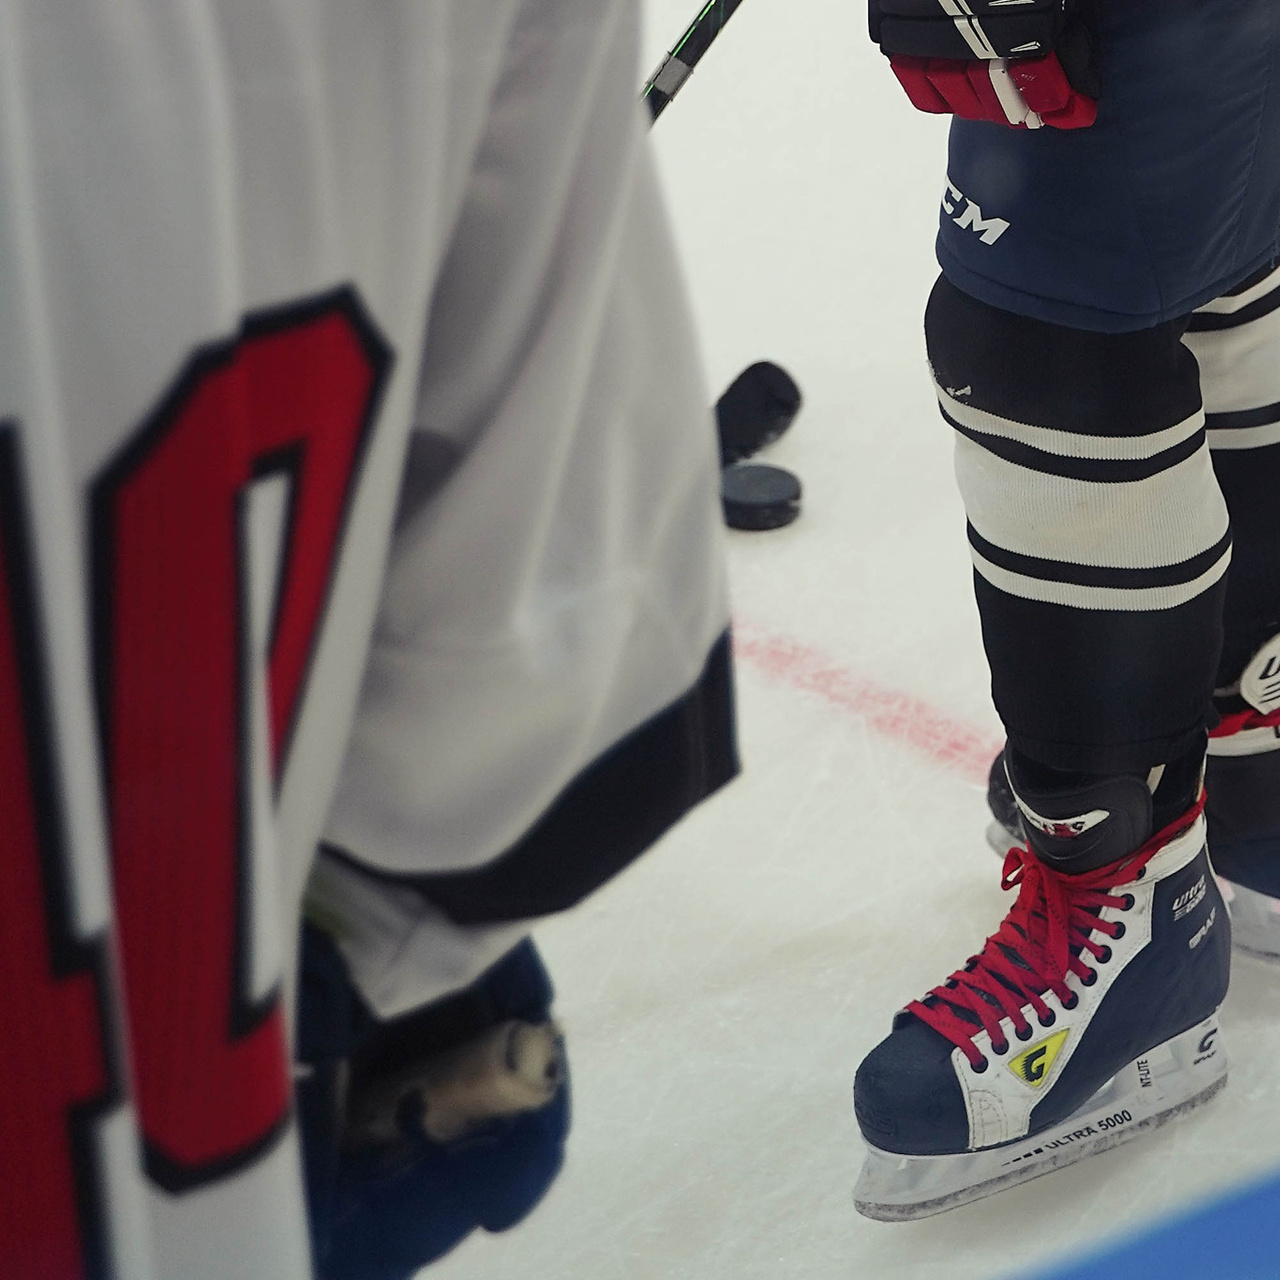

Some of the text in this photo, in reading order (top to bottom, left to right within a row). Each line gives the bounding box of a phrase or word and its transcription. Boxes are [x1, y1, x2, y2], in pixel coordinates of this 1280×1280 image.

[1020, 1044, 1047, 1082] G
[1044, 1109, 1133, 1150] ULTRA 5000
